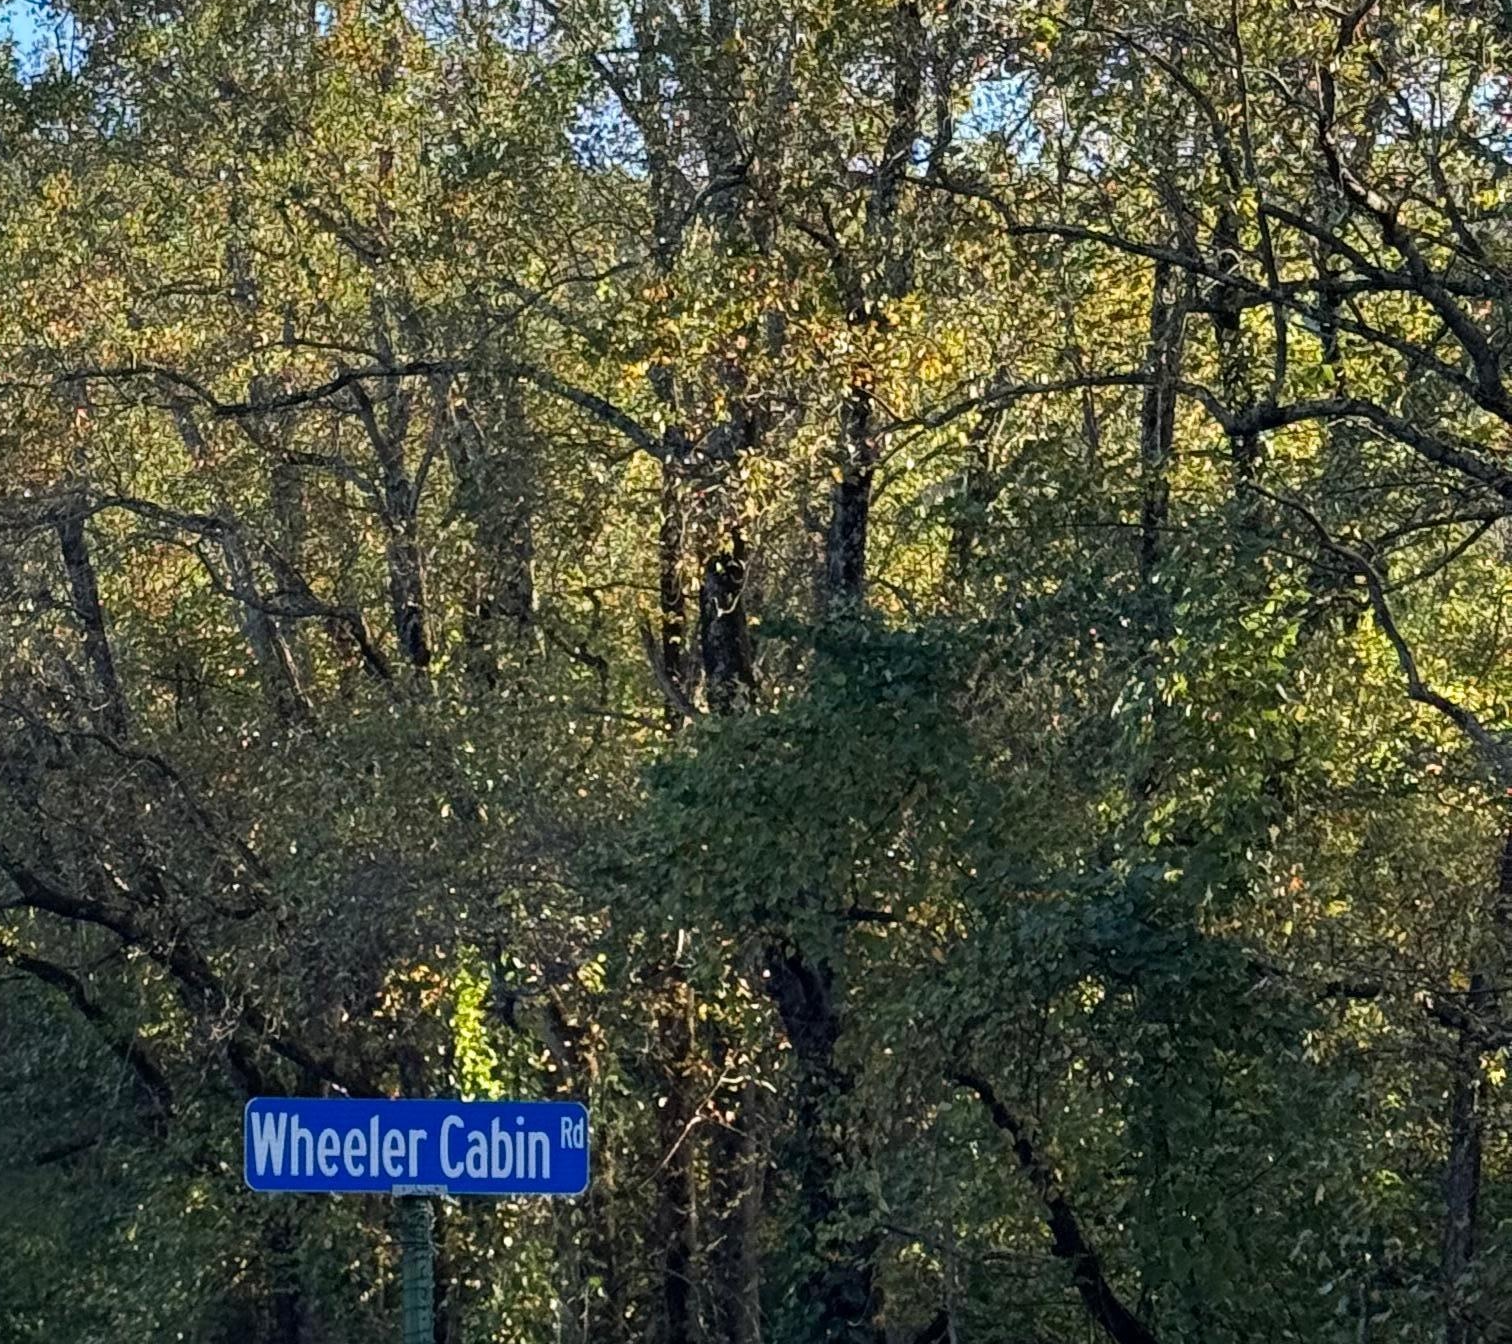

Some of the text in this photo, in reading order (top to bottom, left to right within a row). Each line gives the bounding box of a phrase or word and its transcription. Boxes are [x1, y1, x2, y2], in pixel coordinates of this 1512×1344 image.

[250, 1111, 584, 1180] Wheeler Cabin Rd
